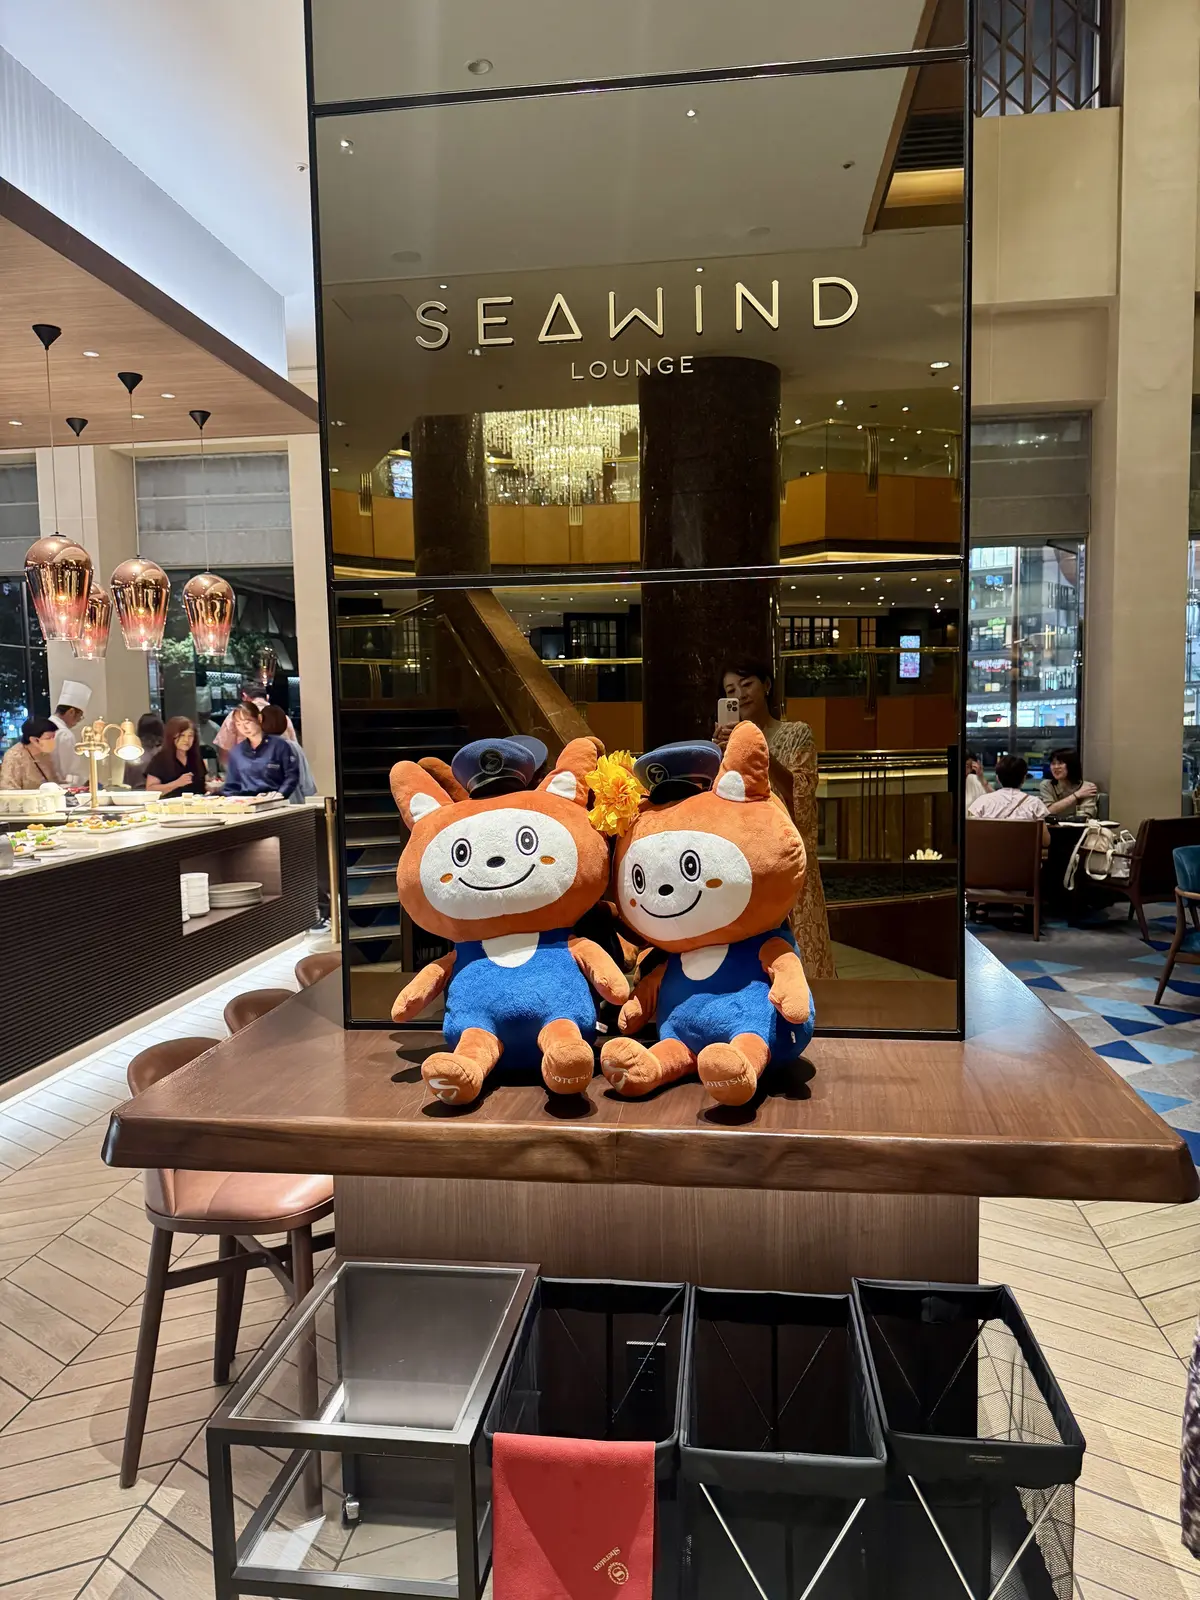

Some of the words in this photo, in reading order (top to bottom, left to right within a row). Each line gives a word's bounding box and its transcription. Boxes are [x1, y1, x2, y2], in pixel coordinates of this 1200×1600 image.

[415, 276, 859, 350] SEAWIND
[571, 355, 694, 380] LOUNGE
[593, 1546, 621, 1571] Sheraton
